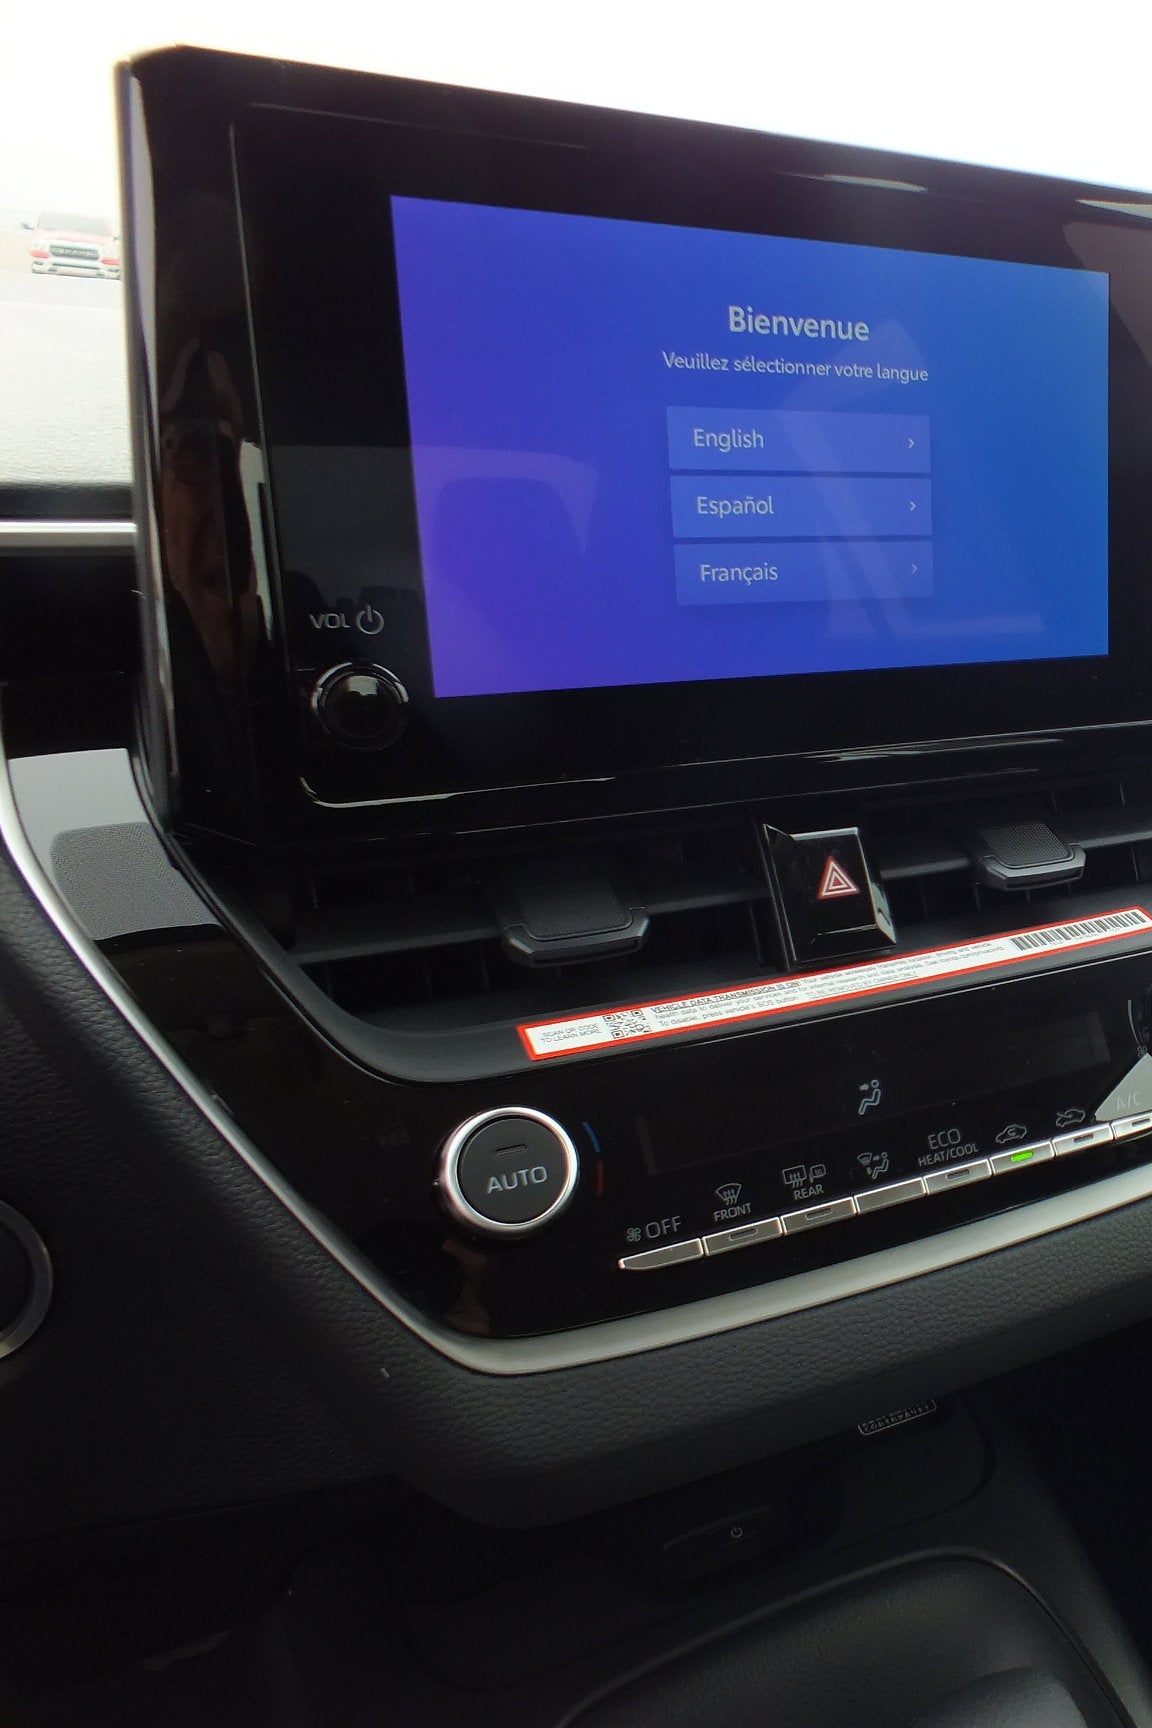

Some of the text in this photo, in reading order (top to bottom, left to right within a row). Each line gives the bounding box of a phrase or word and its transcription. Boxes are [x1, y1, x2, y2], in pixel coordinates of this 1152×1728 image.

[729, 305, 870, 342] Bienvenue
[662, 350, 929, 384] Veuillez sélectionner votre langue
[693, 428, 764, 453] English
[697, 496, 774, 519] Español
[700, 562, 779, 586] Français
[308, 613, 351, 630] VOL
[651, 1000, 688, 1013] VEHICLE
[690, 997, 712, 1008] DATA
[714, 985, 775, 1003] TRANSMISSION
[757, 999, 775, 1008] SOS
[1115, 1091, 1143, 1112] A/C
[927, 1127, 962, 1151] ECO
[917, 1142, 980, 1168] HEAT/COOL
[486, 1165, 549, 1194] AUTO
[793, 1183, 825, 1201] REAR
[713, 1201, 752, 1222] FRONT
[644, 1215, 682, 1240] OFF
